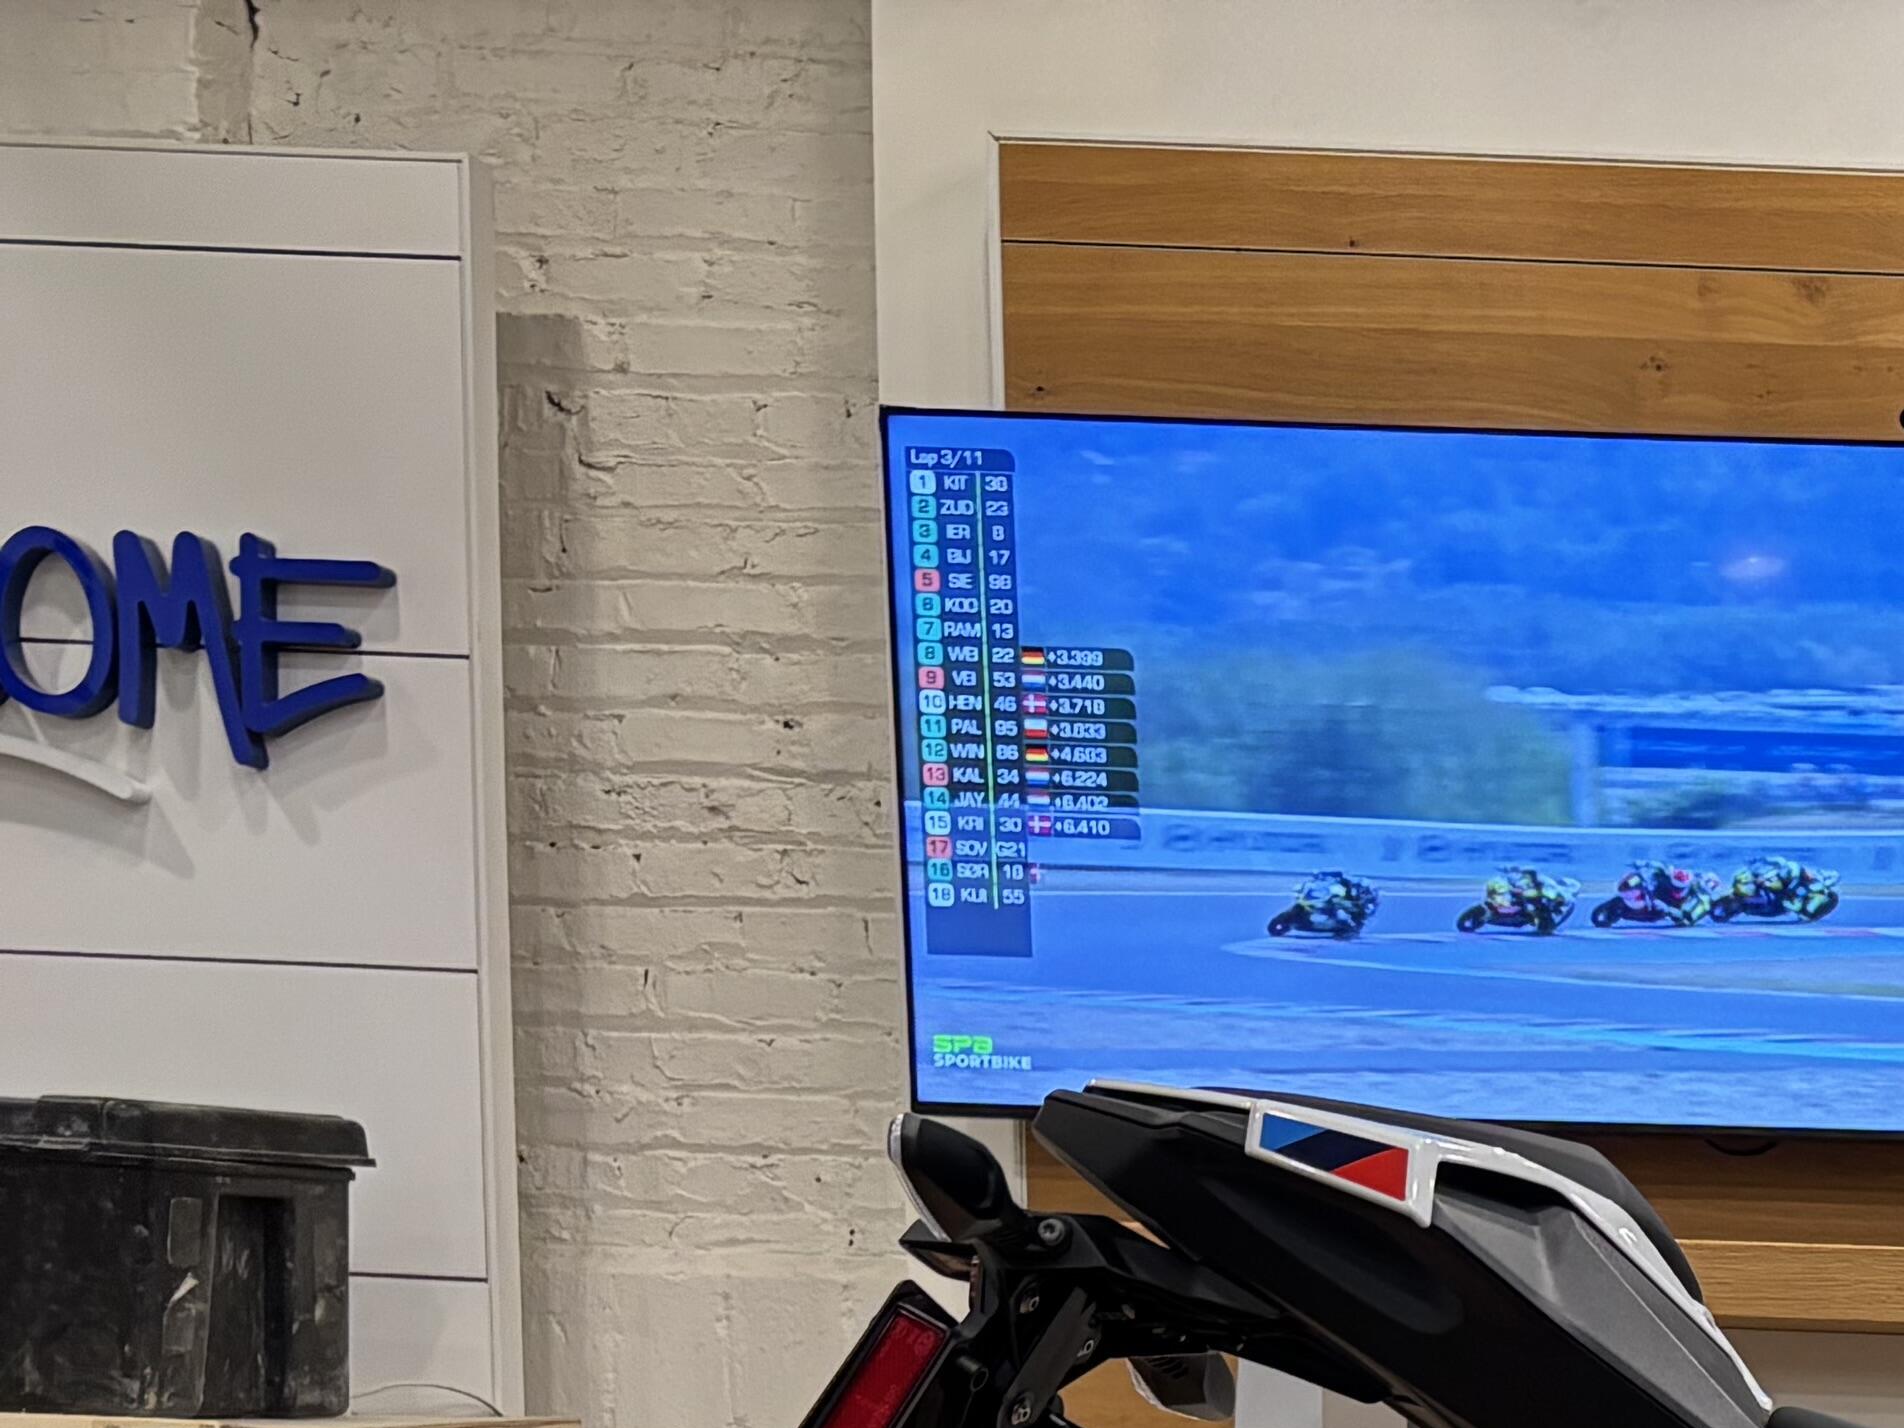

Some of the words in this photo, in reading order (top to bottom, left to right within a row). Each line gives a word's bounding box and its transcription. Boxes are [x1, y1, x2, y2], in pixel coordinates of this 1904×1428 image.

[941, 450, 982, 468] 3/11
[985, 501, 1009, 516] 23
[988, 550, 1010, 565] 17
[989, 599, 1013, 615] 20
[991, 623, 1014, 639] 13
[991, 648, 1015, 663] 22
[992, 672, 1016, 688] 53
[993, 696, 1017, 712] 46
[951, 719, 982, 735] PAL
[952, 767, 985, 783] KAL
[997, 768, 1020, 784] 34
[999, 817, 1022, 833] 30
[1002, 889, 1025, 904] 55
[933, 1053, 1032, 1070] SPORTBIKE
